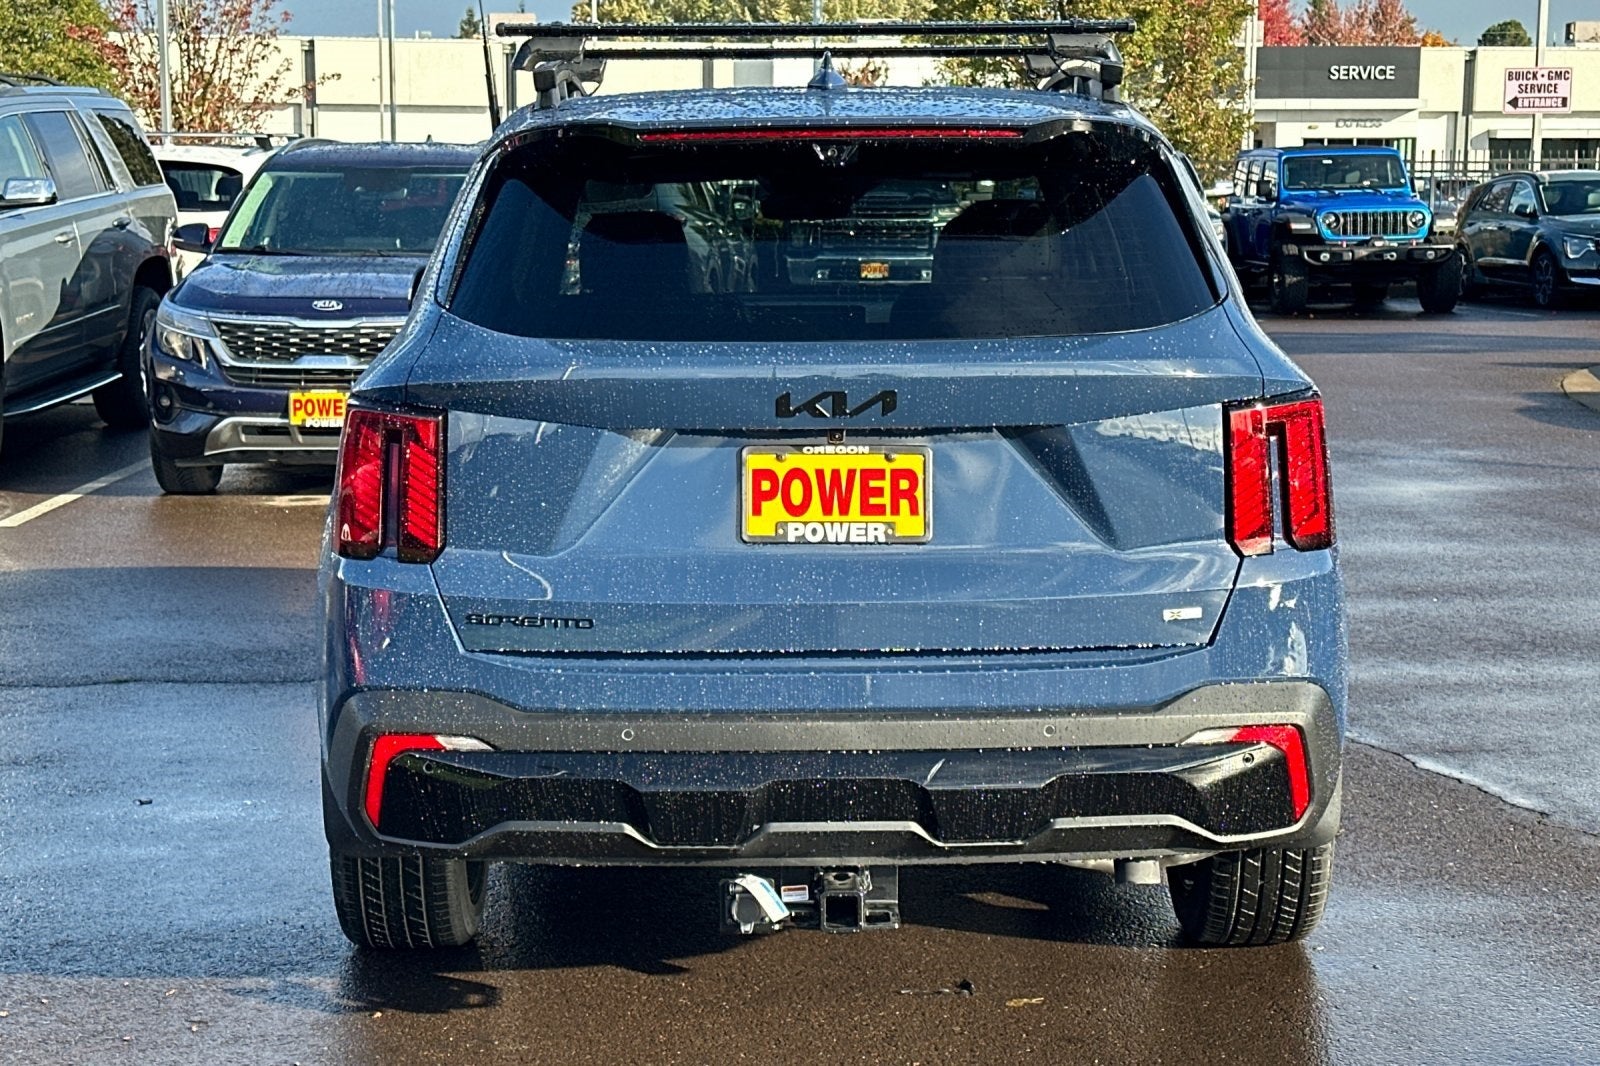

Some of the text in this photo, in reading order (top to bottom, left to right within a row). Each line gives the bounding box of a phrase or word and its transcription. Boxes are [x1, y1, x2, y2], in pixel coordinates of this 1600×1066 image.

[1329, 65, 1396, 80] SERVICE
[1508, 70, 1570, 81] BUICK GMC
[1518, 83, 1558, 94] SERVICE
[1518, 97, 1562, 107] ENTRANCE
[293, 398, 343, 417] POWE
[802, 446, 869, 454] OREGON
[751, 467, 920, 517] POWER
[787, 522, 886, 543] POWER
[465, 614, 594, 629] SORENTO
